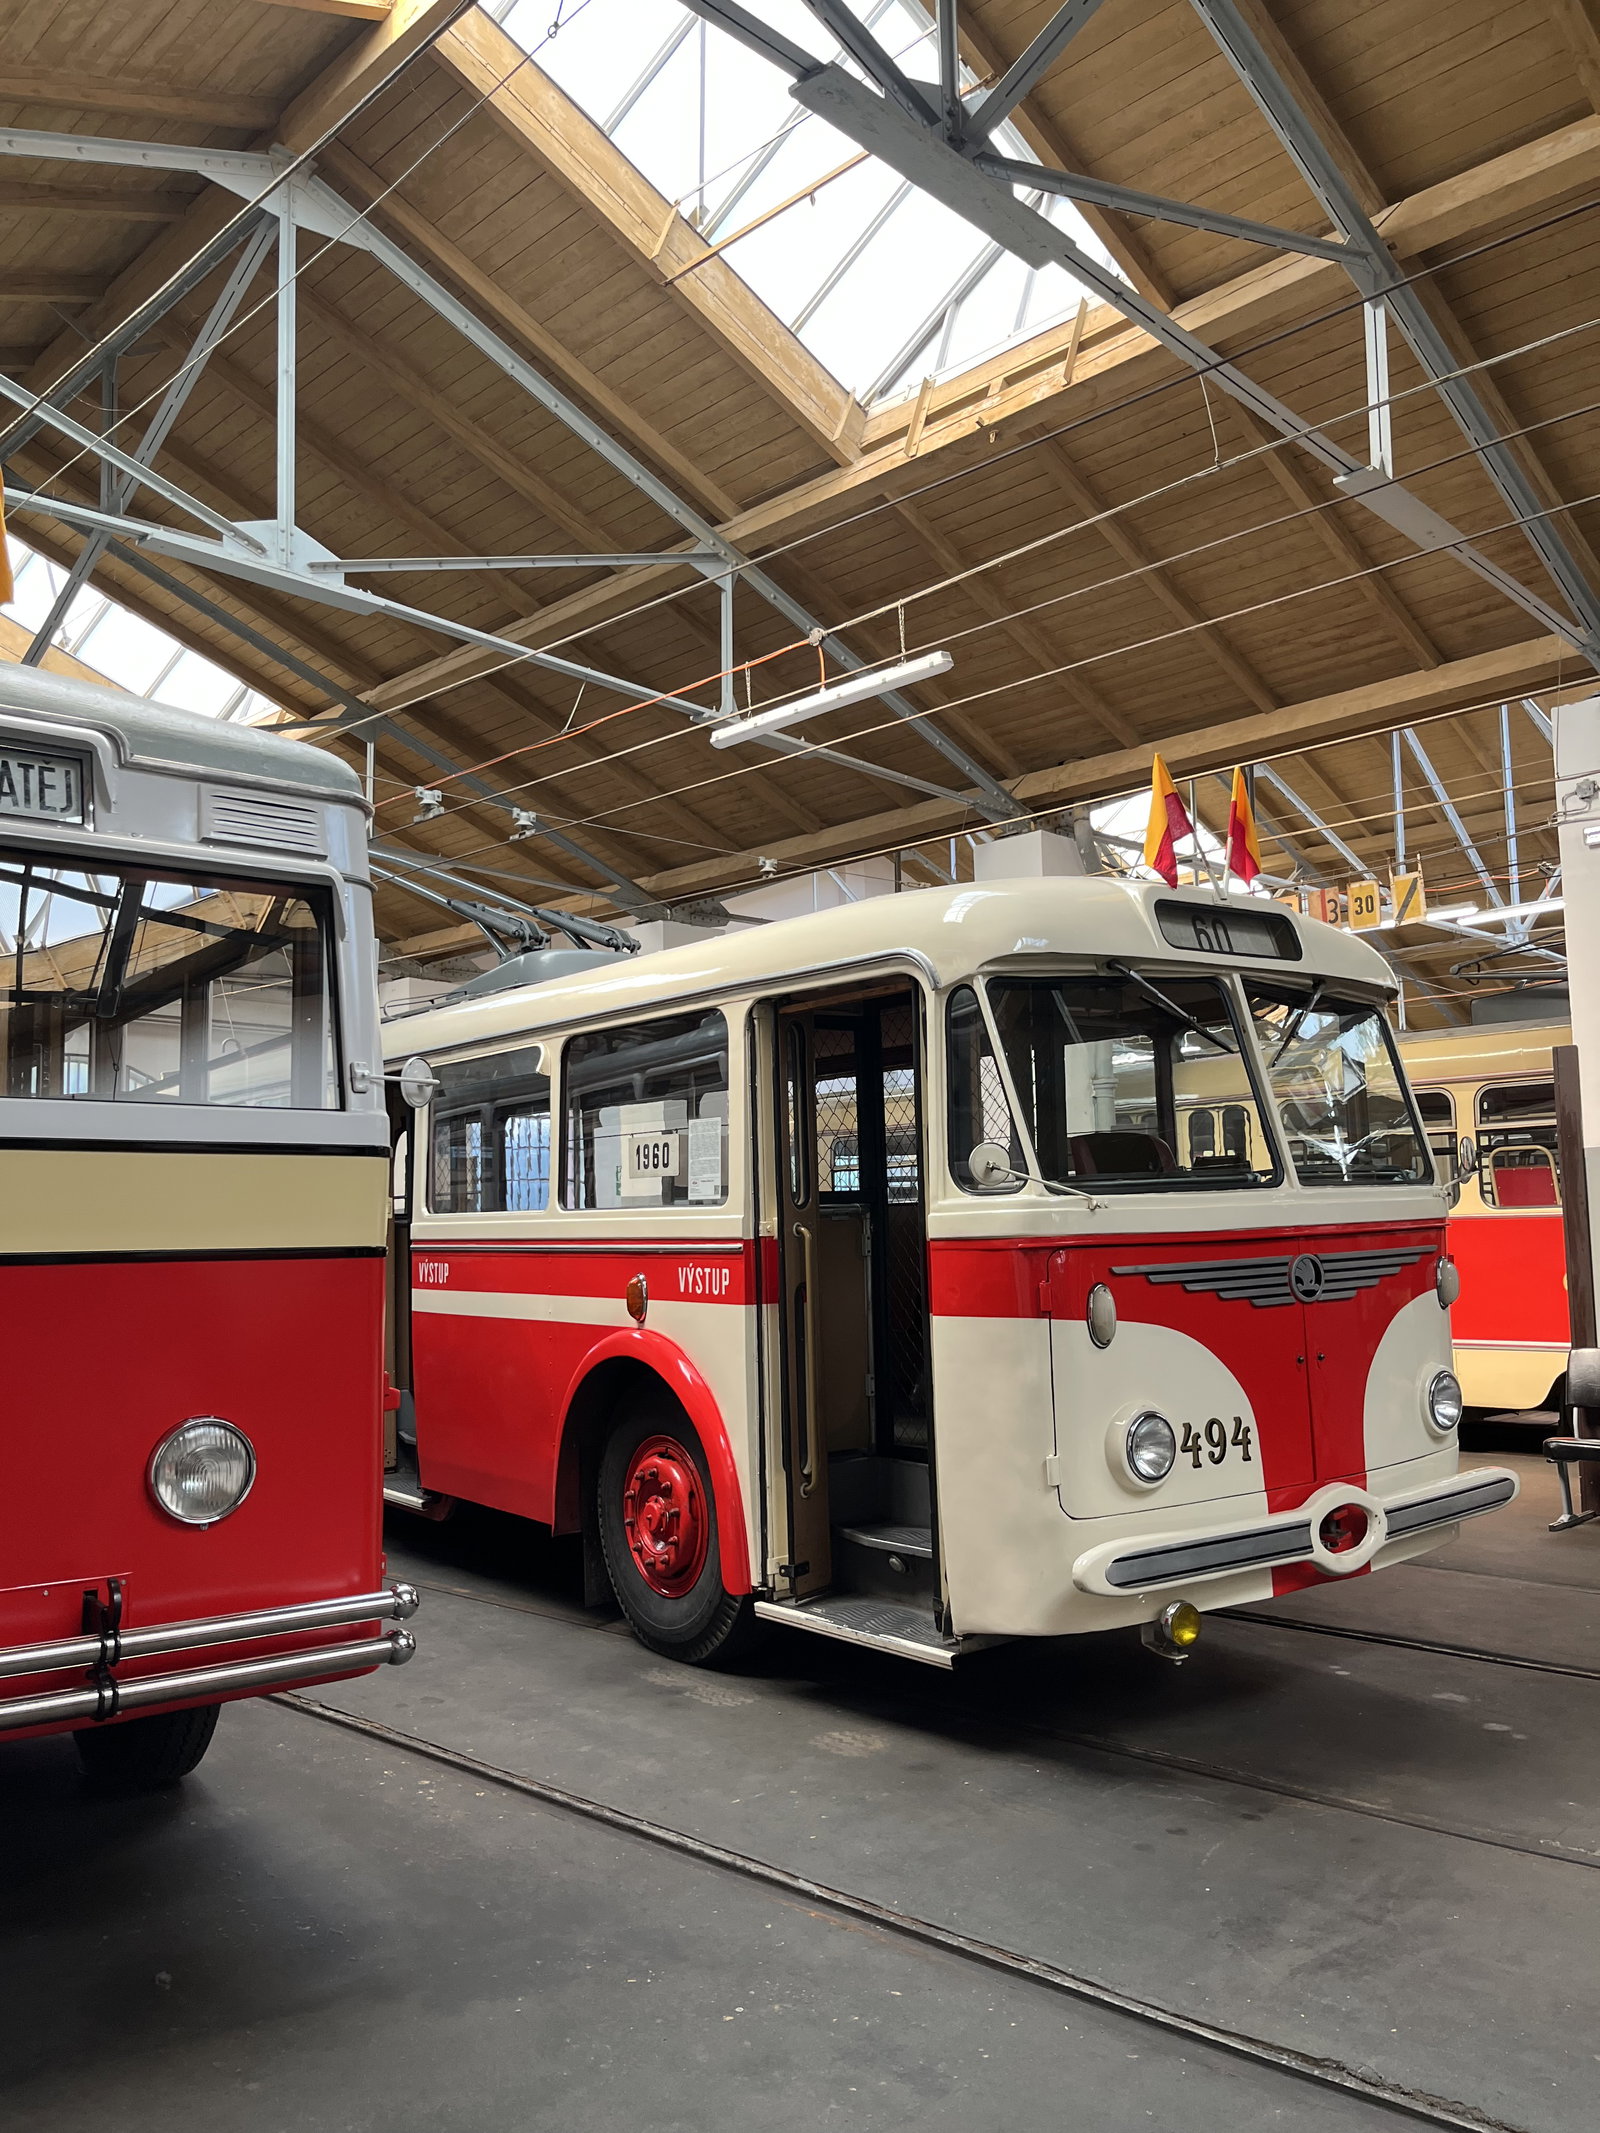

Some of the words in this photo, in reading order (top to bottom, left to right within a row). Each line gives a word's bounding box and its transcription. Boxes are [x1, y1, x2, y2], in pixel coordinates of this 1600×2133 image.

[1326, 898, 1339, 924] 3
[1354, 894, 1375, 916] 30
[1191, 914, 1234, 953] 60
[635, 1142, 670, 1171] 1960
[418, 1258, 450, 1284] VÝSTUP
[678, 1262, 730, 1296] VÝSTUP
[1180, 1416, 1252, 1469] 494
